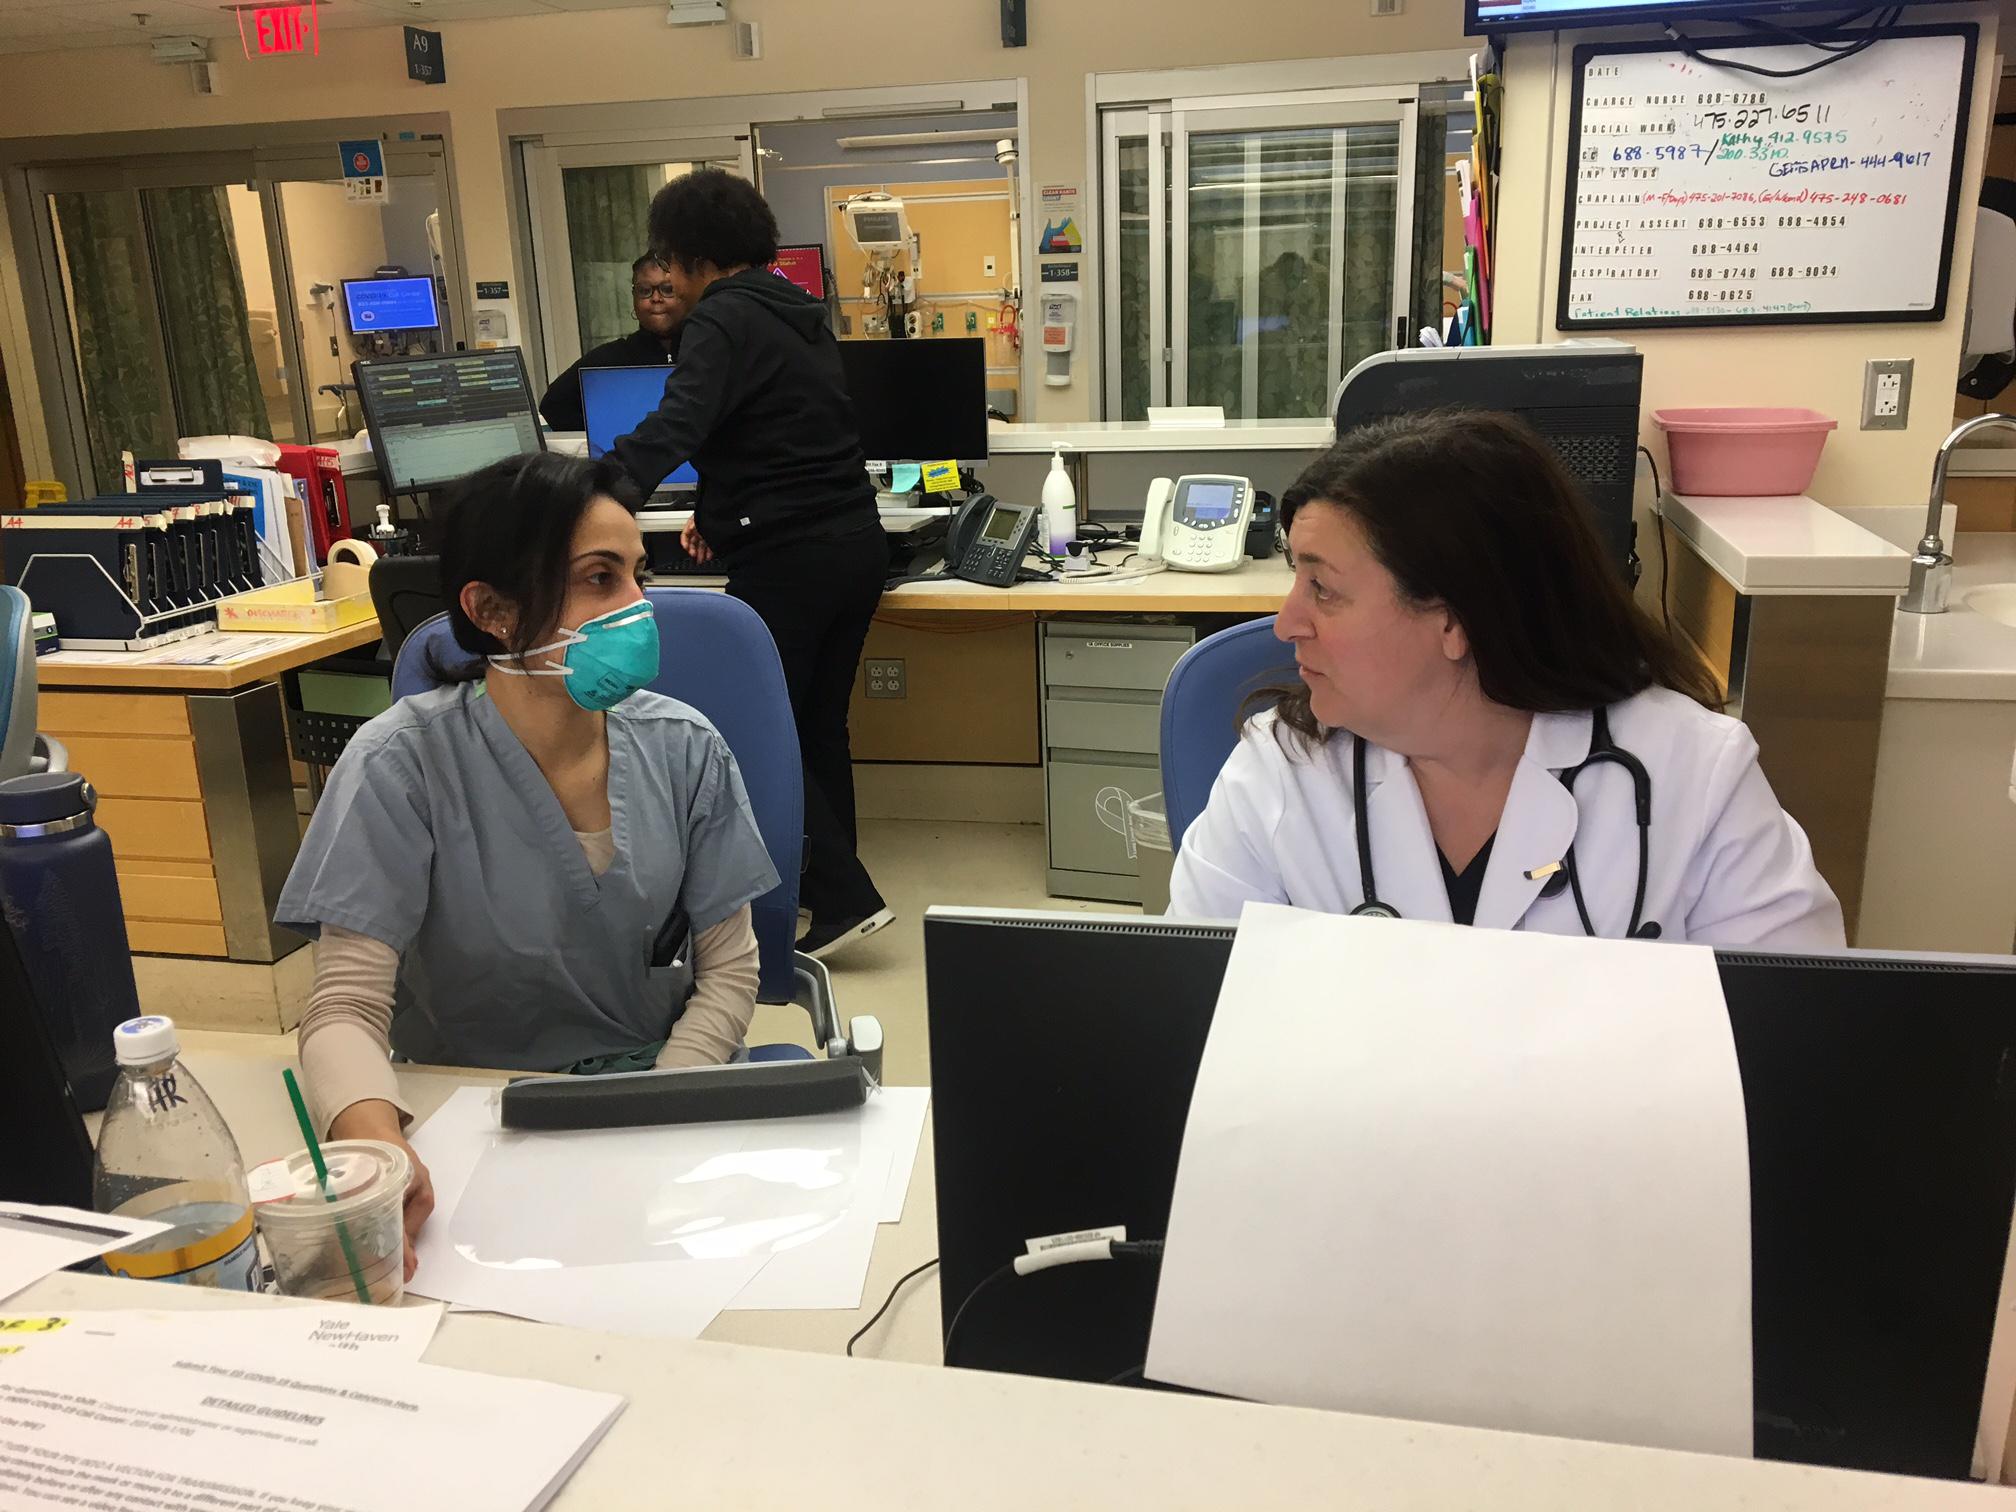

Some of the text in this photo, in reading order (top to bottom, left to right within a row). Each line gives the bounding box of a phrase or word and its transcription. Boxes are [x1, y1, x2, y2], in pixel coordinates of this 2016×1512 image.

[254, 7, 304, 54] EXIT
[413, 34, 429, 53] A9
[1588, 67, 1619, 77] DATE
[1586, 92, 1766, 106] CHARGE NURSE 688-6786
[1583, 124, 1629, 133] SOCIAL
[1578, 194, 1640, 204] CHAPLAIN
[1576, 216, 1846, 229] PROJECT ASSERT 688-6553 688-4854
[1574, 243, 1759, 255] INTERPETER 688-4464
[1572, 265, 1837, 279] RESPIRATORY 688-8748 688-9034
[1571, 290, 1753, 302] FAX 688-0625
[5, 517, 134, 528] A4 A4
[318, 1319, 351, 1331] Yale
[200, 1396, 327, 1427] DETAILED GUIDELINES
